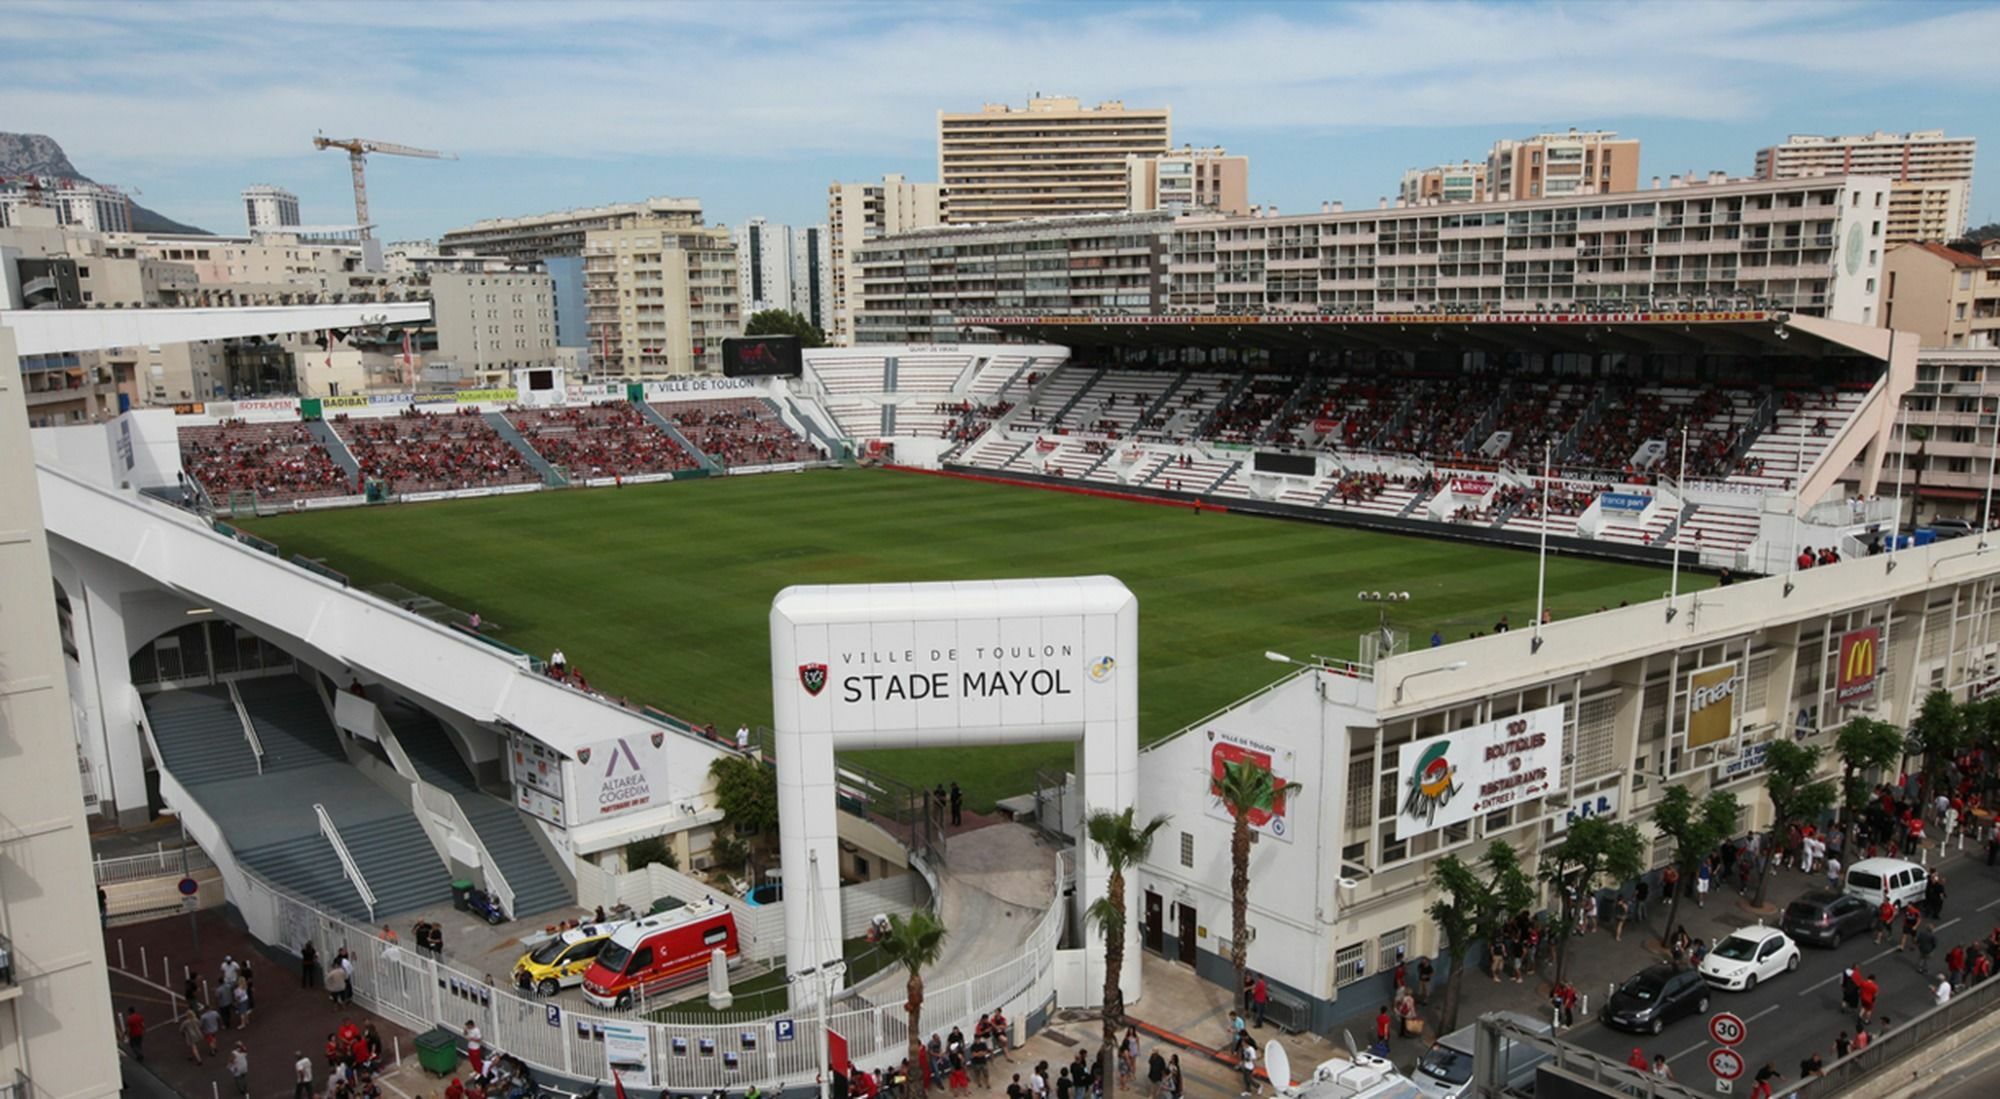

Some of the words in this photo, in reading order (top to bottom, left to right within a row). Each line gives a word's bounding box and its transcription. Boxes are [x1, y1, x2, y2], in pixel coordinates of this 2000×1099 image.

[1649, 312, 1757, 322] BOISSONS
[457, 390, 490, 400] Mutuelle
[493, 390, 502, 399] du
[659, 382, 688, 392] VILLE
[693, 381, 707, 391] DE
[712, 379, 754, 390] TOULON
[239, 401, 292, 410] SOTRAPIM
[323, 398, 368, 408] BADIBAT
[842, 650, 913, 664] VILLE
[931, 649, 957, 662] DE
[976, 645, 1072, 659] TOULON
[843, 672, 949, 703] STADE
[963, 668, 1071, 697] MAYOL
[1691, 676, 1738, 712] fnac
[1221, 733, 1237, 743] VILLE
[1249, 740, 1276, 753] TOULON
[1485, 732, 1547, 762] BOUTIQUES
[601, 773, 647, 792] ALTAREA
[1480, 767, 1547, 797] RESTAURANTS
[599, 784, 650, 804] COGEDIM
[1401, 780, 1464, 827] MAYOL
[1718, 1022, 1738, 1038] 30
